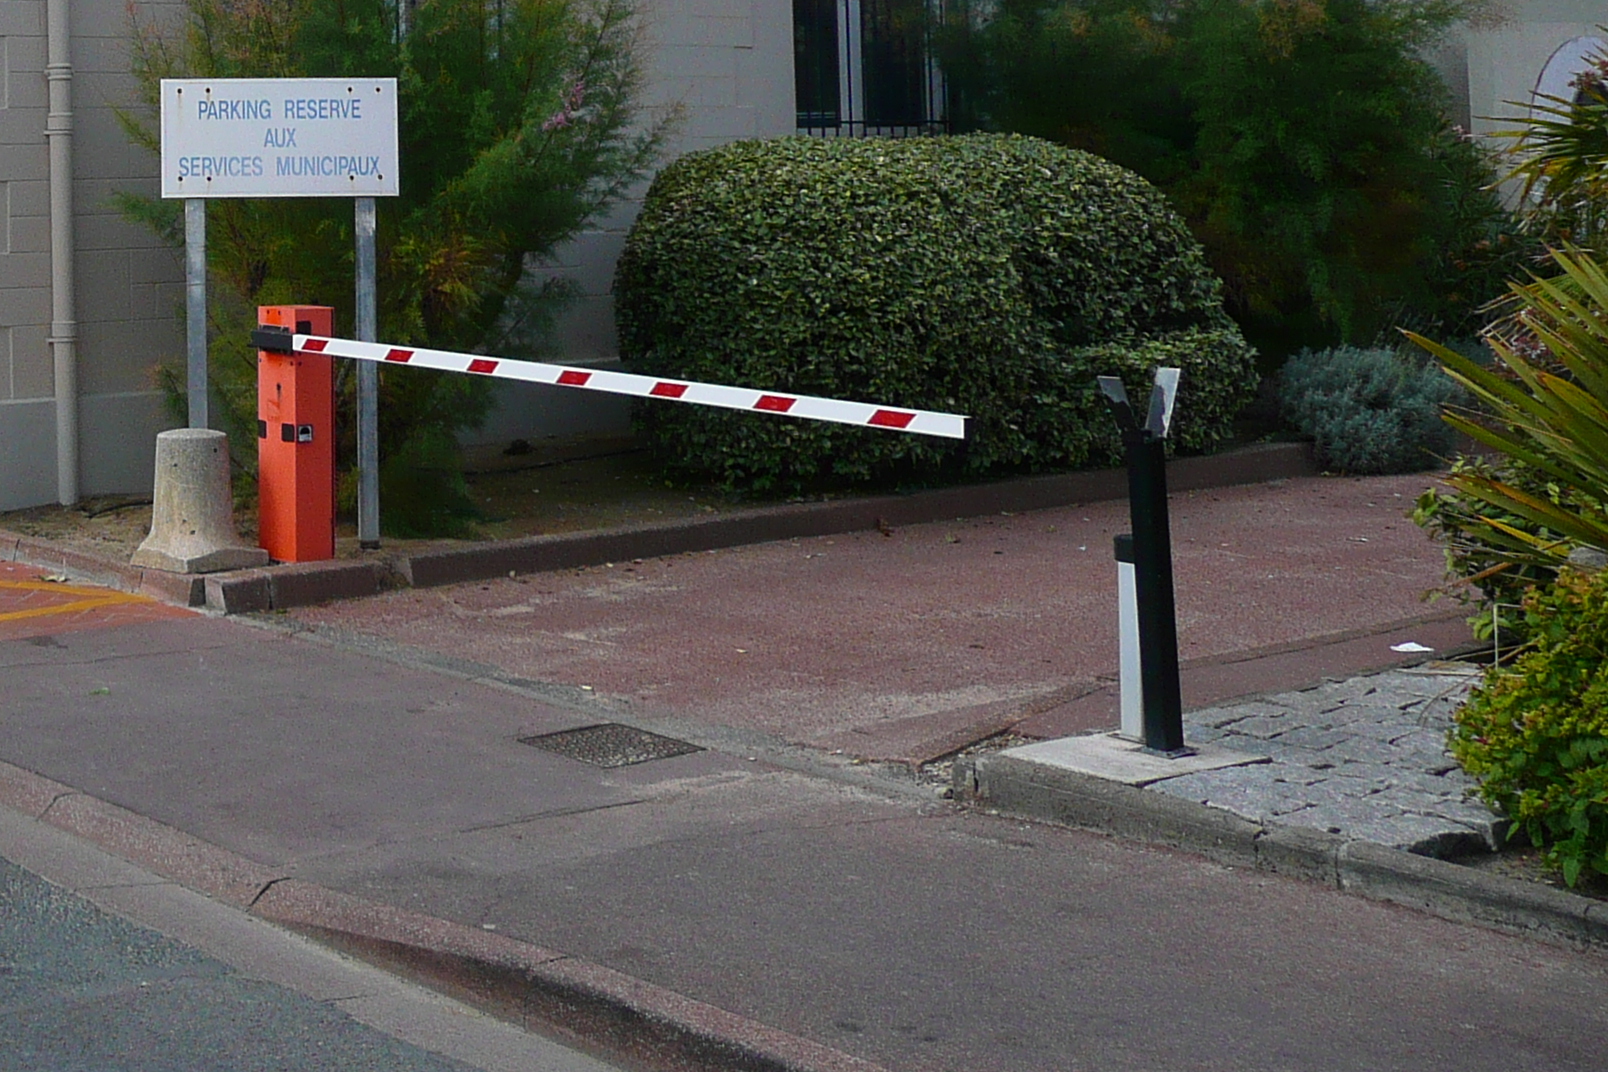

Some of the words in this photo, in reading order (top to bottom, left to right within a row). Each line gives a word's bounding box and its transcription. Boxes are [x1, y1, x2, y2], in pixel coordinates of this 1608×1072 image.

[198, 100, 272, 120] PARKING
[284, 99, 361, 119] RESERVE
[264, 128, 297, 148] AUX
[178, 156, 263, 177] SERVICES
[276, 156, 380, 176] MUNICIPAUX
